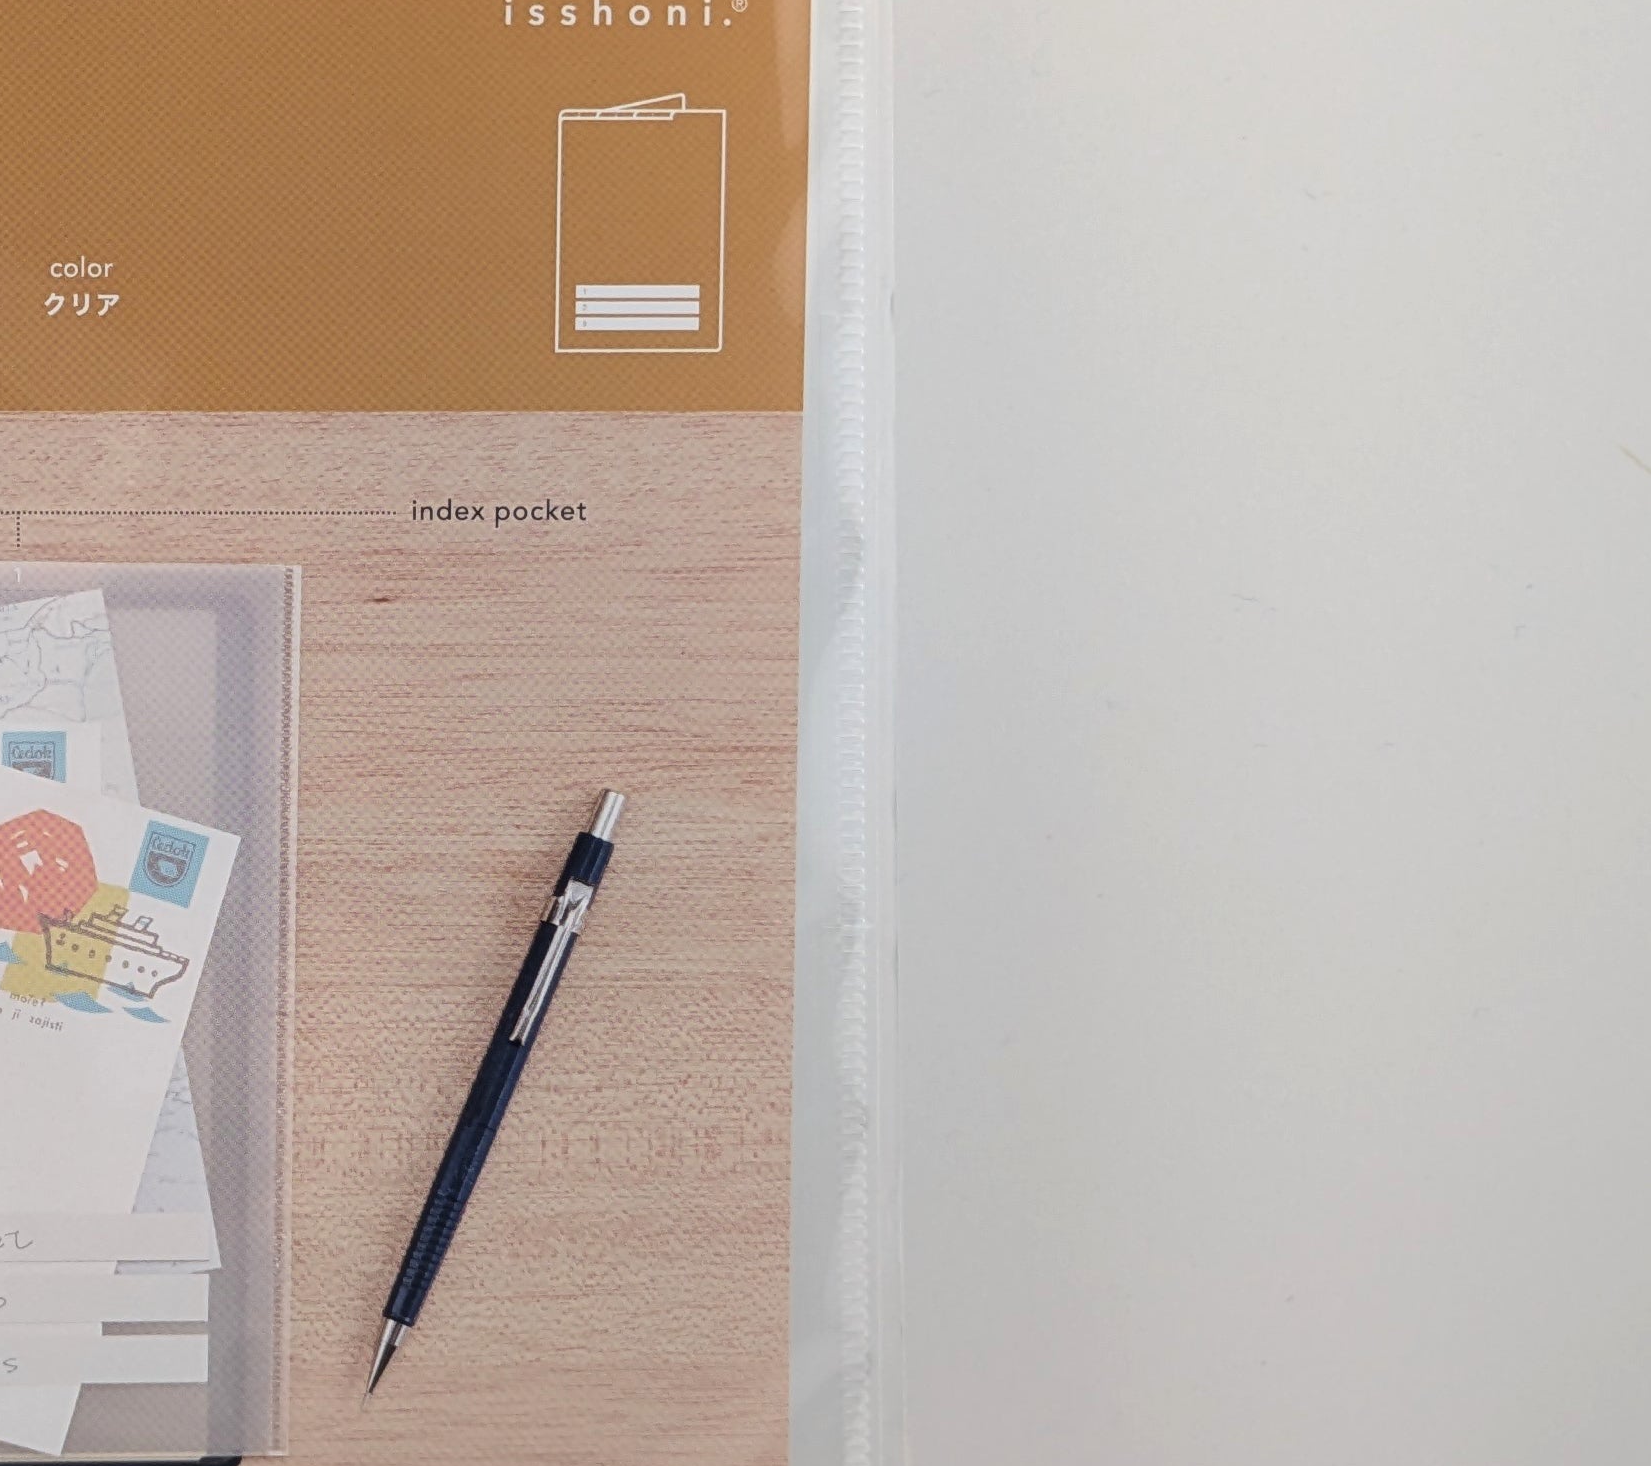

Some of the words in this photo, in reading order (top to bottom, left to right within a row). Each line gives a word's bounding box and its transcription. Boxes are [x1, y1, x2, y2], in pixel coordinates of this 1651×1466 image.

[49, 255, 114, 279] color
[43, 291, 121, 318] クリア
[410, 497, 486, 524] index
[493, 497, 588, 527] pocket
